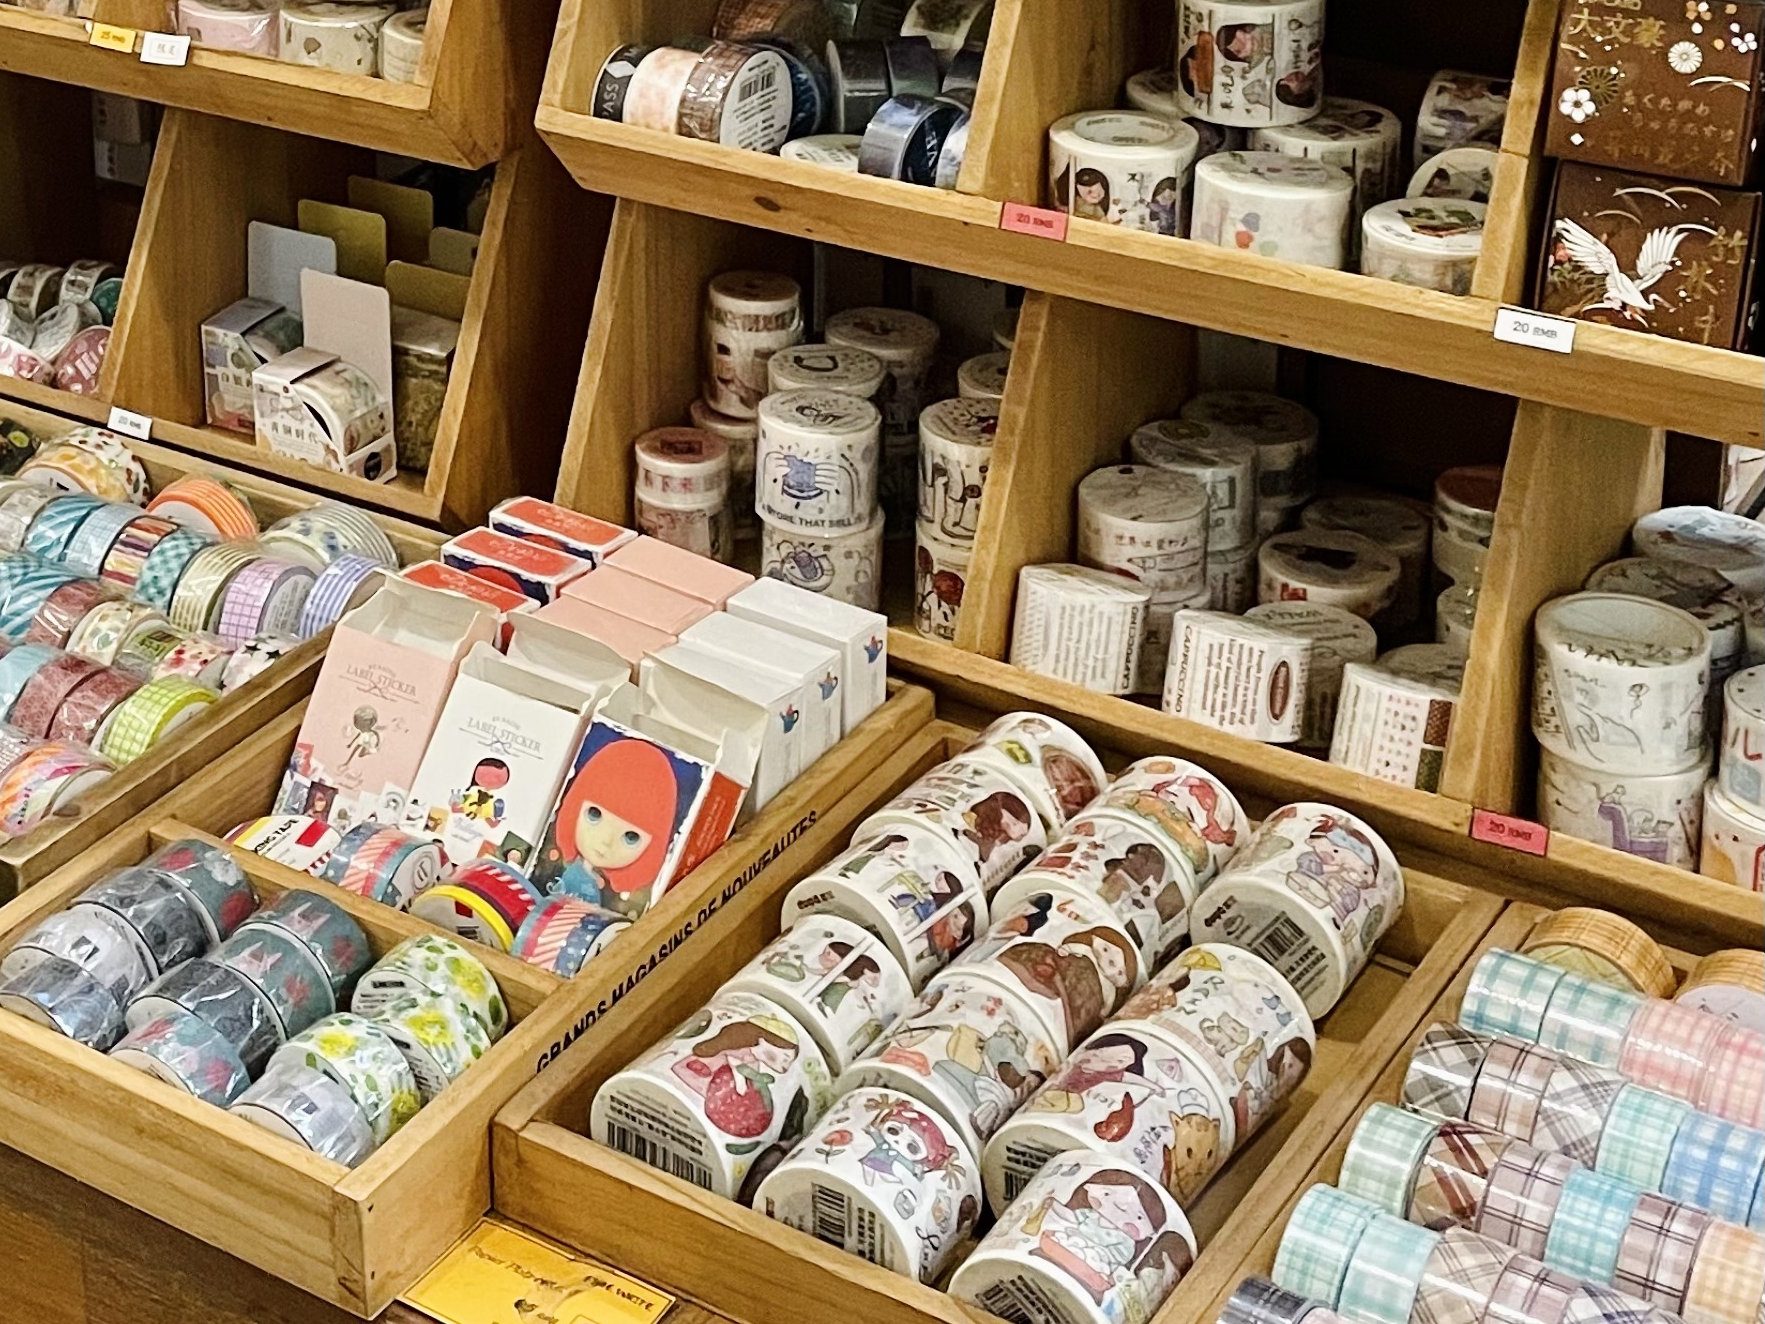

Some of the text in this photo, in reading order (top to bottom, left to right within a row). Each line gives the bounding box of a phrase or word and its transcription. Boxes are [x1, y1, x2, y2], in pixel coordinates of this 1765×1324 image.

[1512, 320, 1530, 334] 20
[346, 663, 374, 683] LABEL
[377, 675, 418, 697] STICKER
[467, 716, 497, 738] LABEL
[499, 728, 542, 753] STICKER
[535, 809, 818, 1077] GRANDS MAGASINS DE NOUVEAUTES
